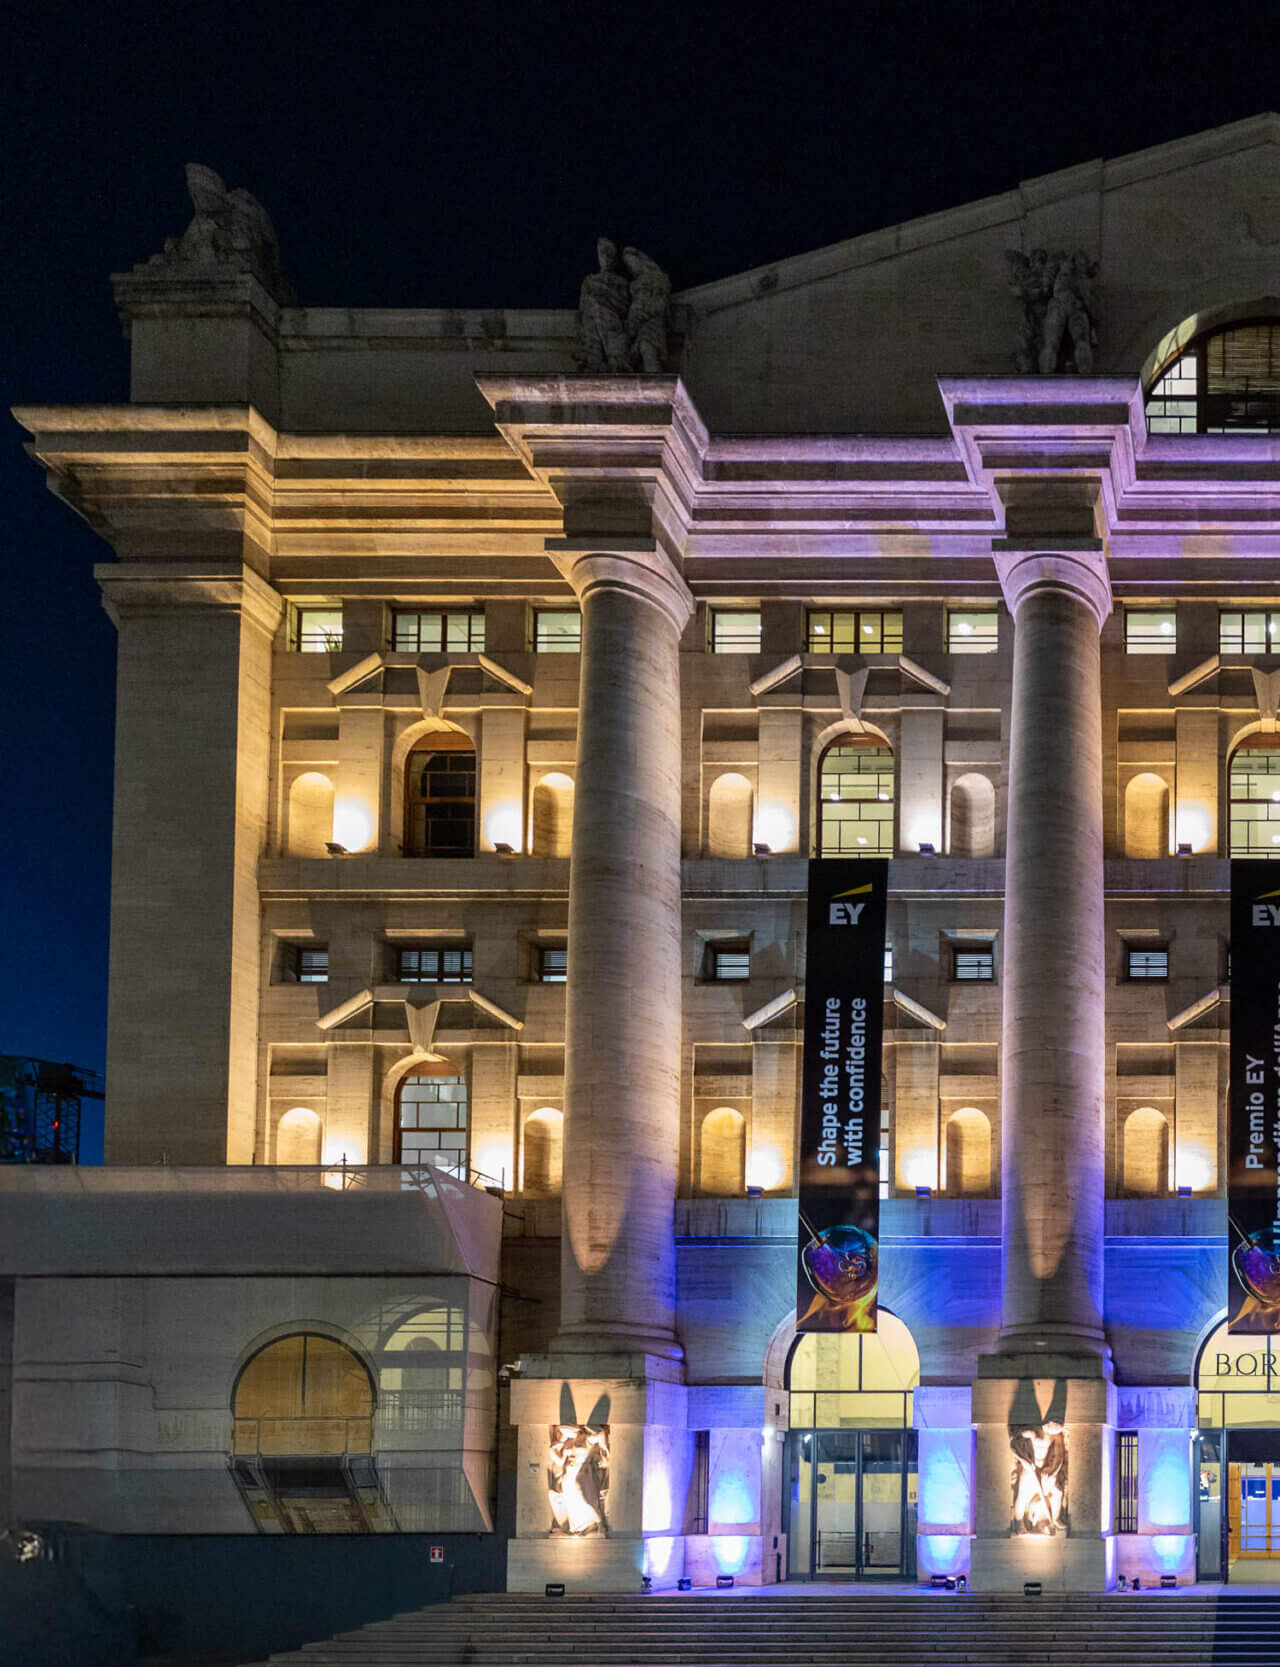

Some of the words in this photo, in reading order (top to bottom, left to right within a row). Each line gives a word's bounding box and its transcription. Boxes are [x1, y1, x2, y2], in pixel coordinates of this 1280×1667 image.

[829, 903, 865, 925] EY
[820, 997, 841, 1060] future
[845, 998, 867, 1113] confidence
[819, 1064, 839, 1098] the
[1245, 1054, 1265, 1084] EY
[817, 1102, 841, 1167] Shape
[844, 1118, 864, 1167] with
[1245, 1092, 1265, 1169] Premio
